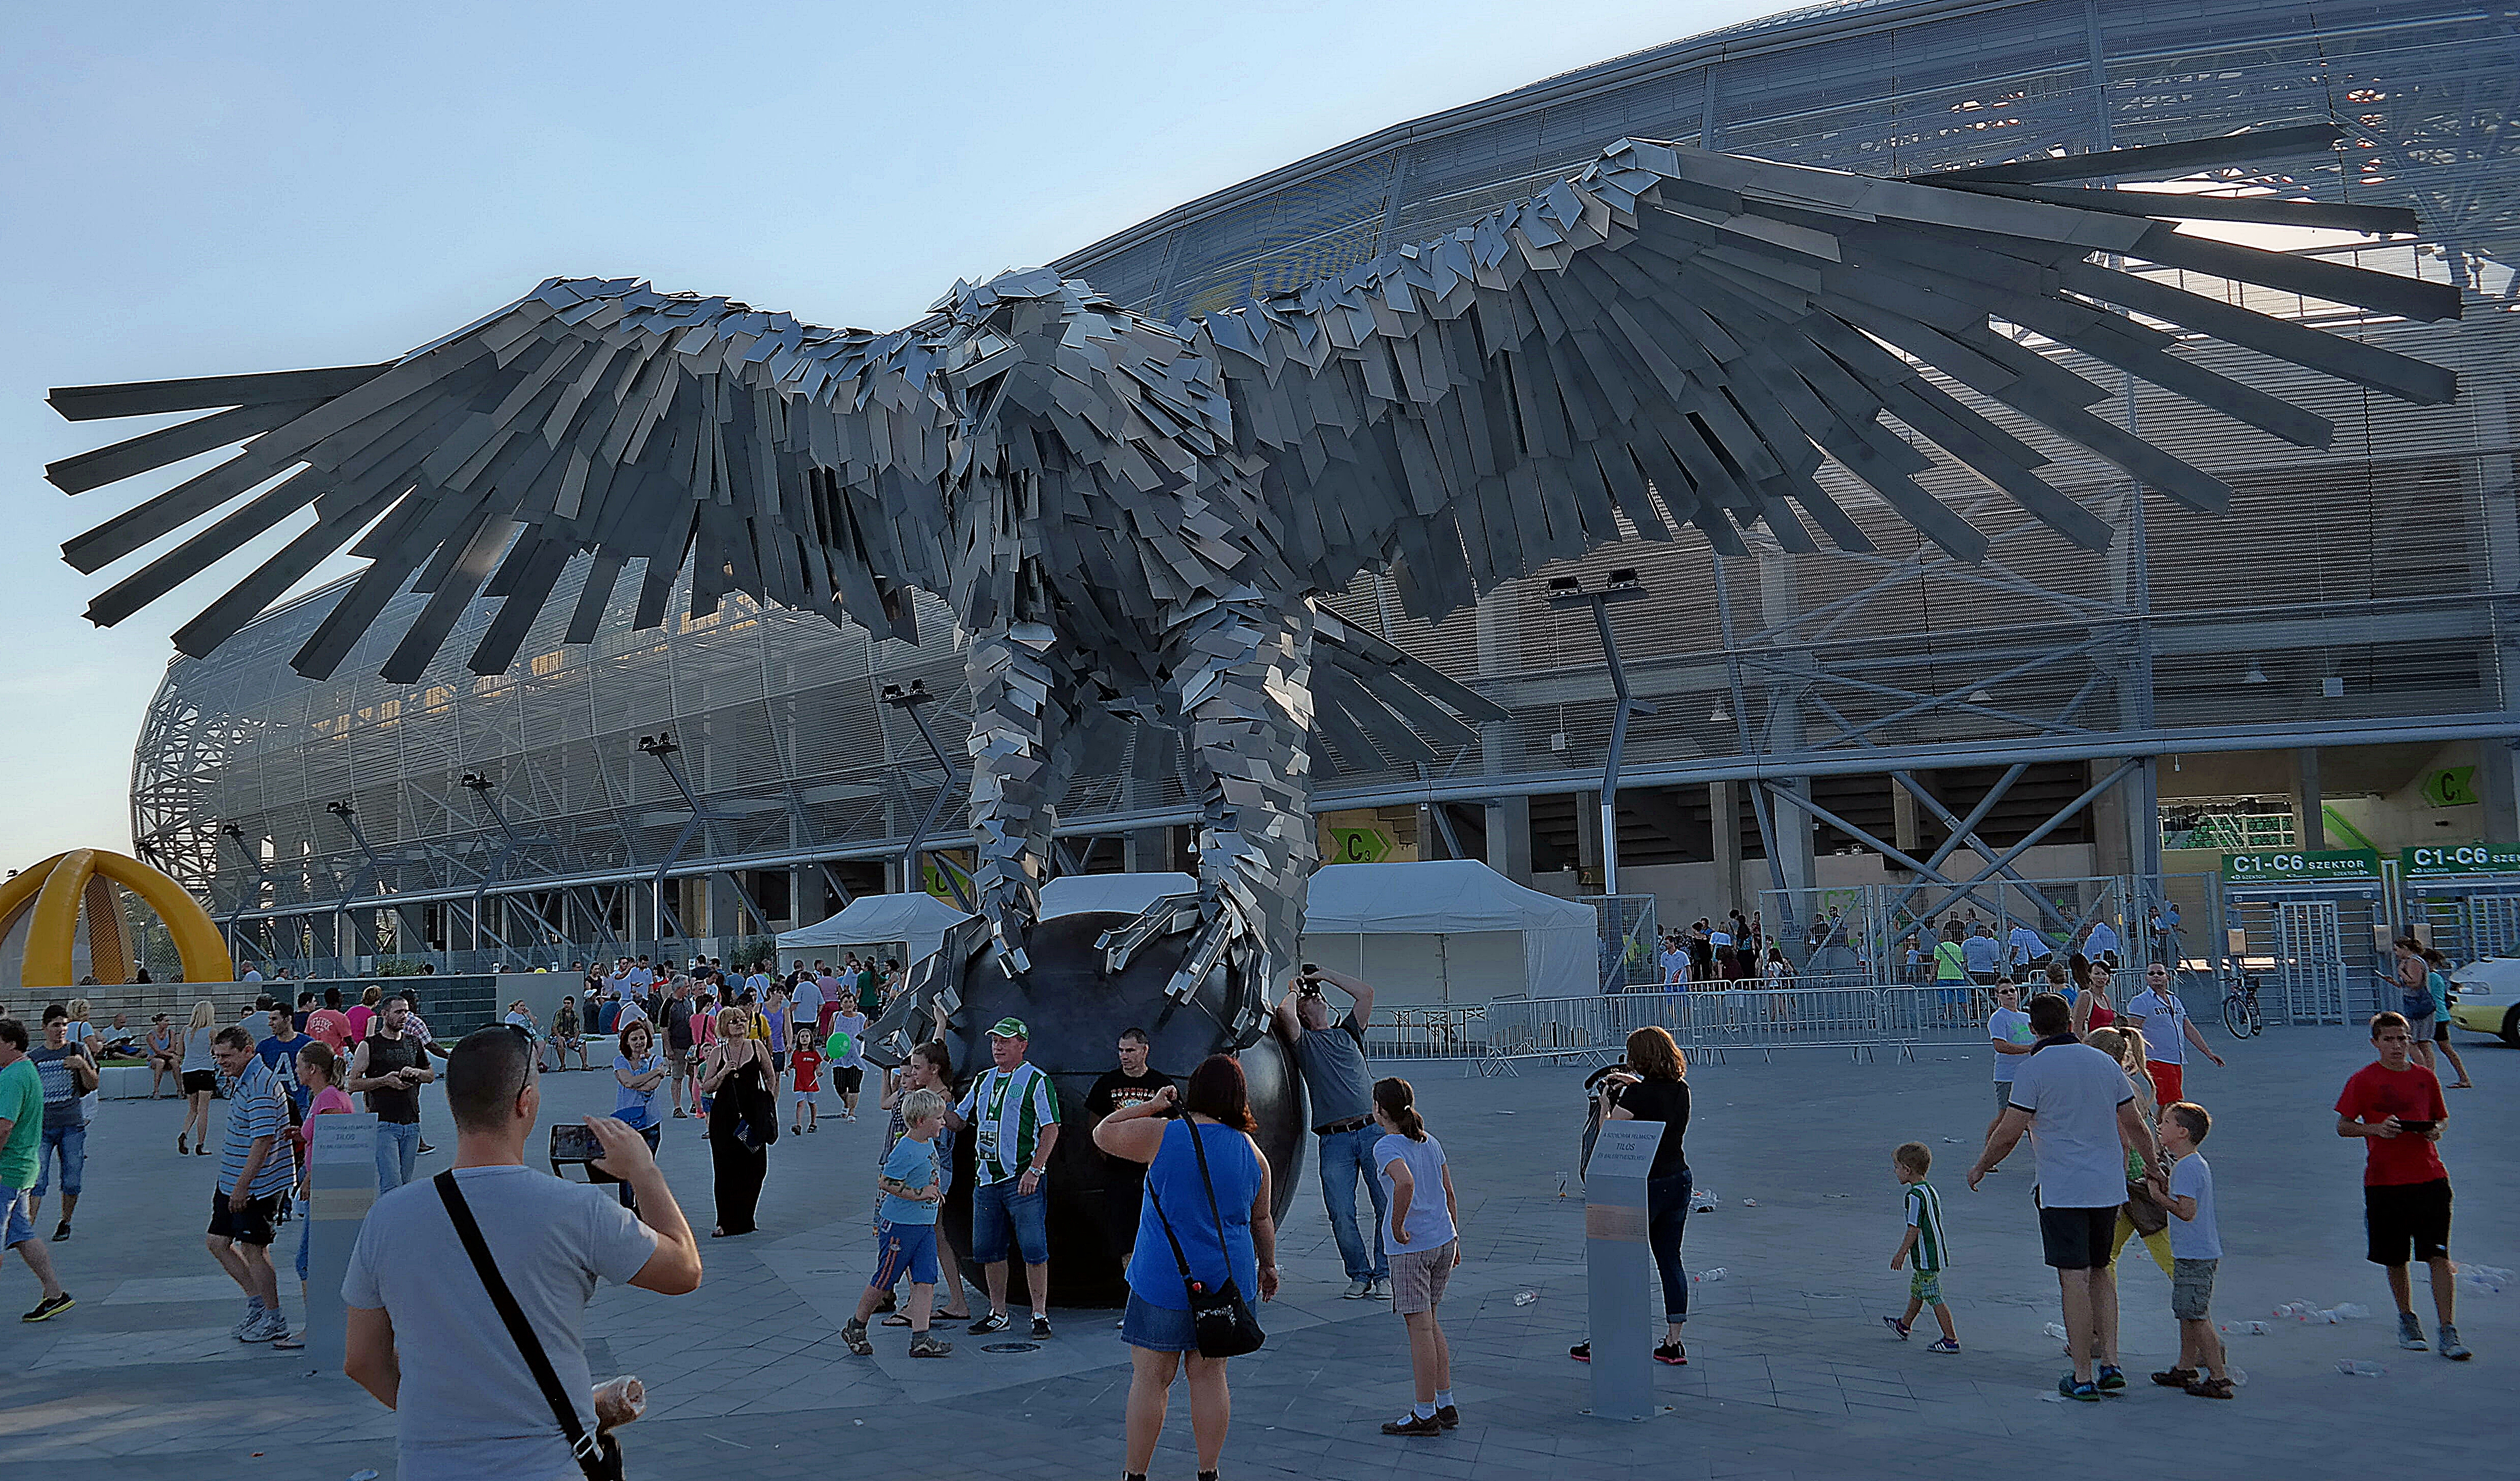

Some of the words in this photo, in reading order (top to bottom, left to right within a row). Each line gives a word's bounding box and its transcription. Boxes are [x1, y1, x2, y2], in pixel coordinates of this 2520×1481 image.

[1347, 833, 1371, 861] C3
[2414, 846, 2489, 866] C1-C6
[2492, 854, 2520, 863] SZE
[2233, 854, 2304, 872] C1-C6
[2308, 860, 2365, 870] SZEKTOR
[267, 1052, 298, 1092] A
